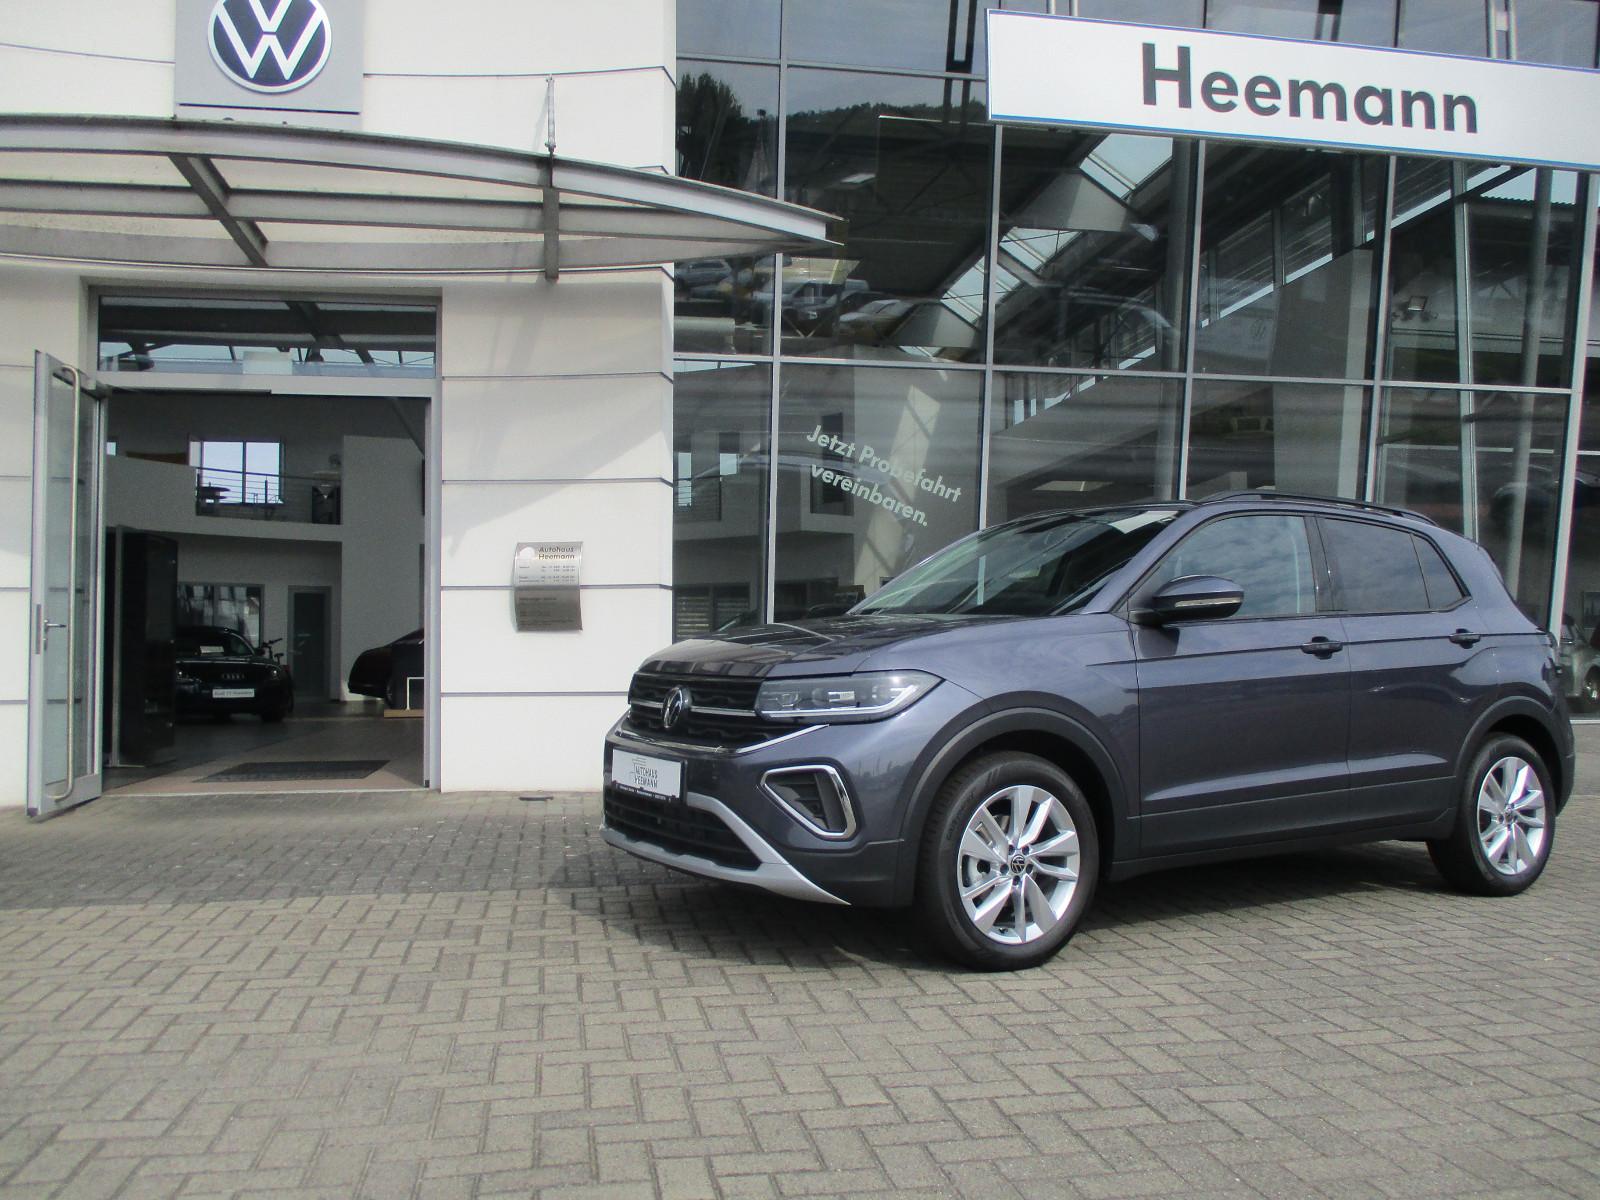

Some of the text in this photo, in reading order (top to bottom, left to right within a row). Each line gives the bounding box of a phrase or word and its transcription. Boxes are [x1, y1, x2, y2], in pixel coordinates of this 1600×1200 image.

[1142, 42, 1478, 134] Heemann
[806, 424, 962, 502] Jetzt Probefahrt
[810, 463, 928, 527] vereinbaren.
